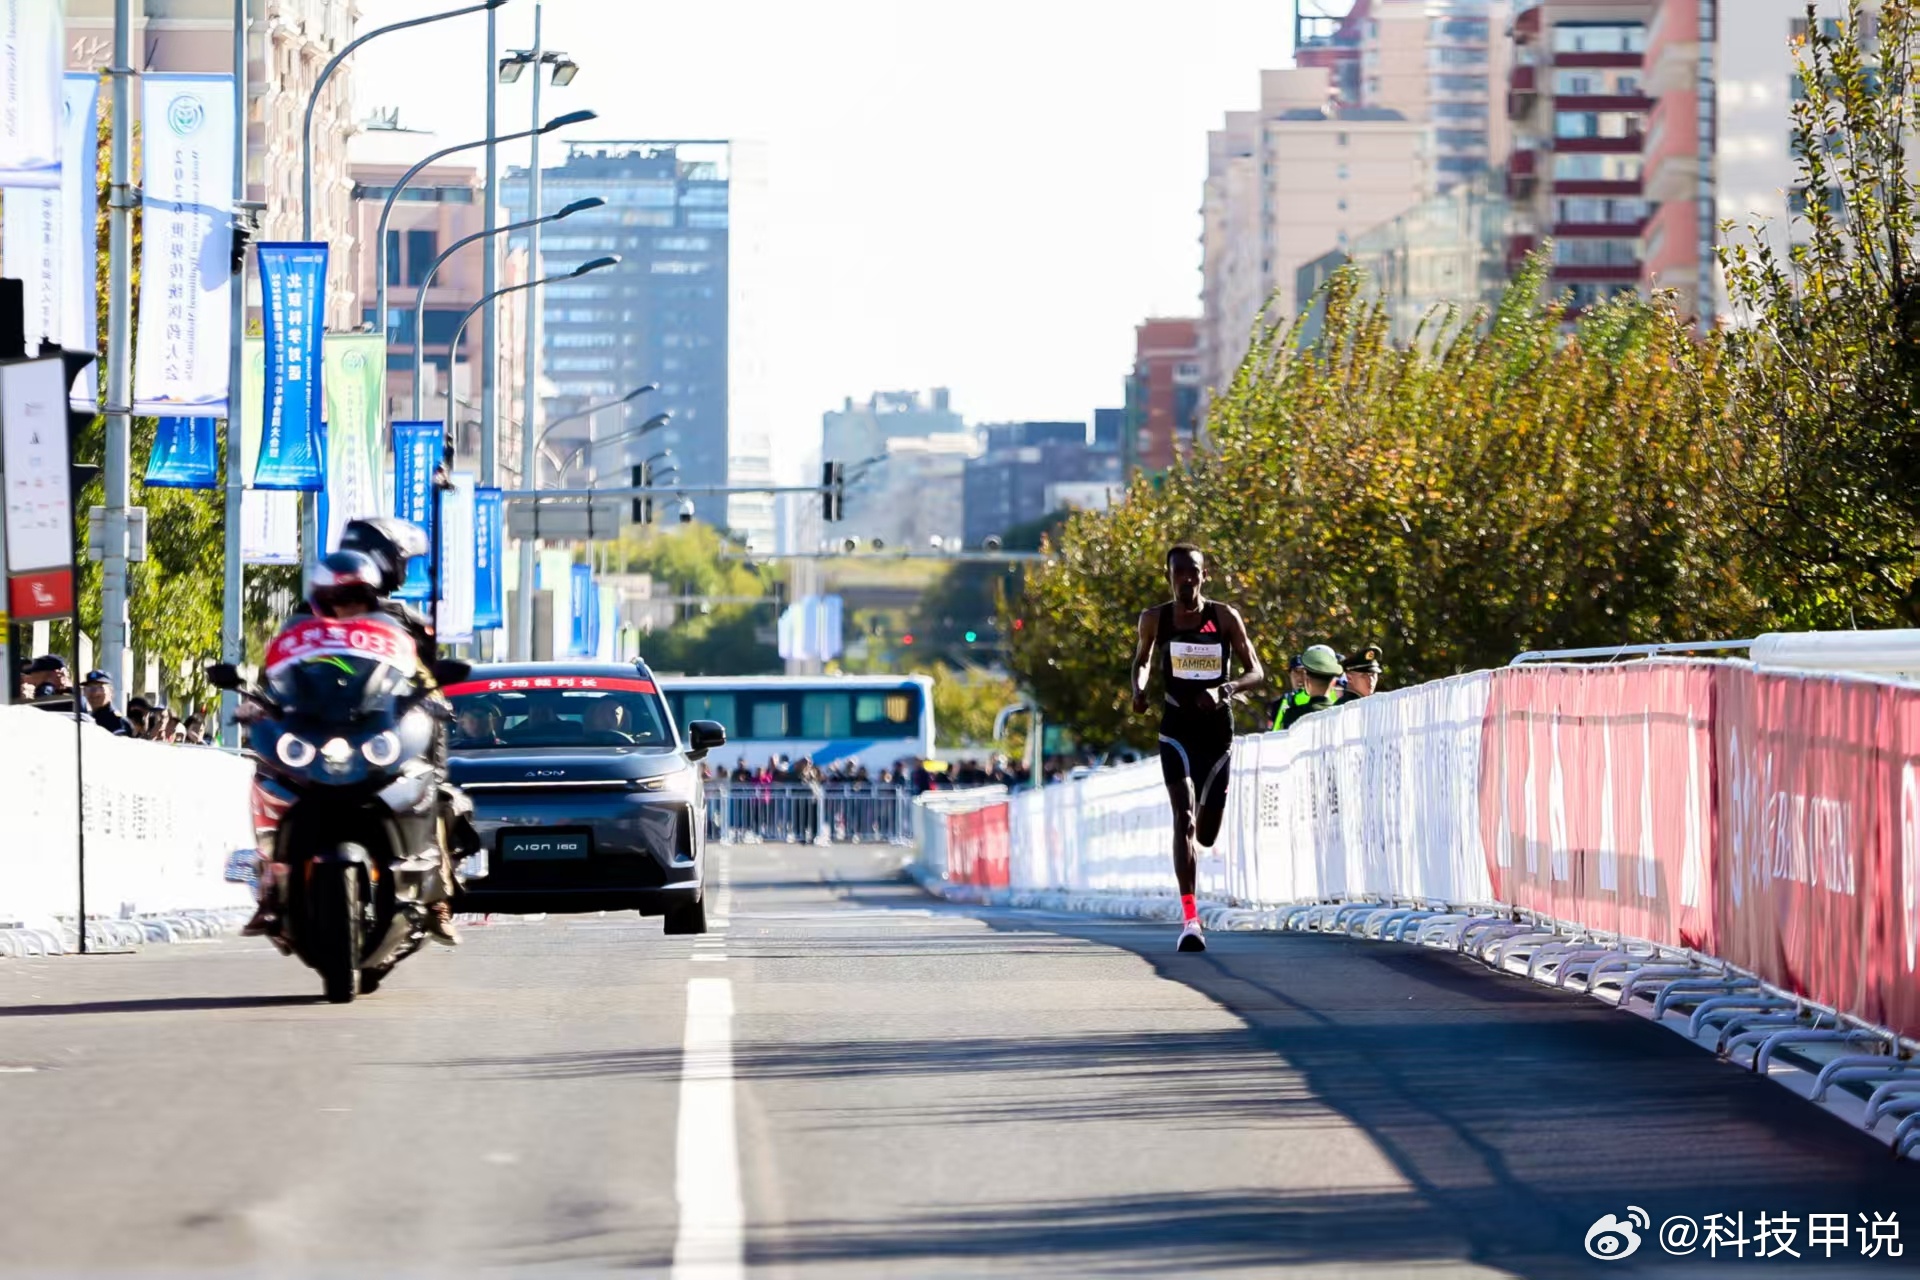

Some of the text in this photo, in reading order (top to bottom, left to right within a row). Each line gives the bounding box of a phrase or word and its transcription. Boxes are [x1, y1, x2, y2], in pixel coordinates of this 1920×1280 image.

[1177, 658, 1217, 669] TAMIRAT
[489, 678, 597, 689] 外场裁判长
[513, 843, 551, 852] AION
